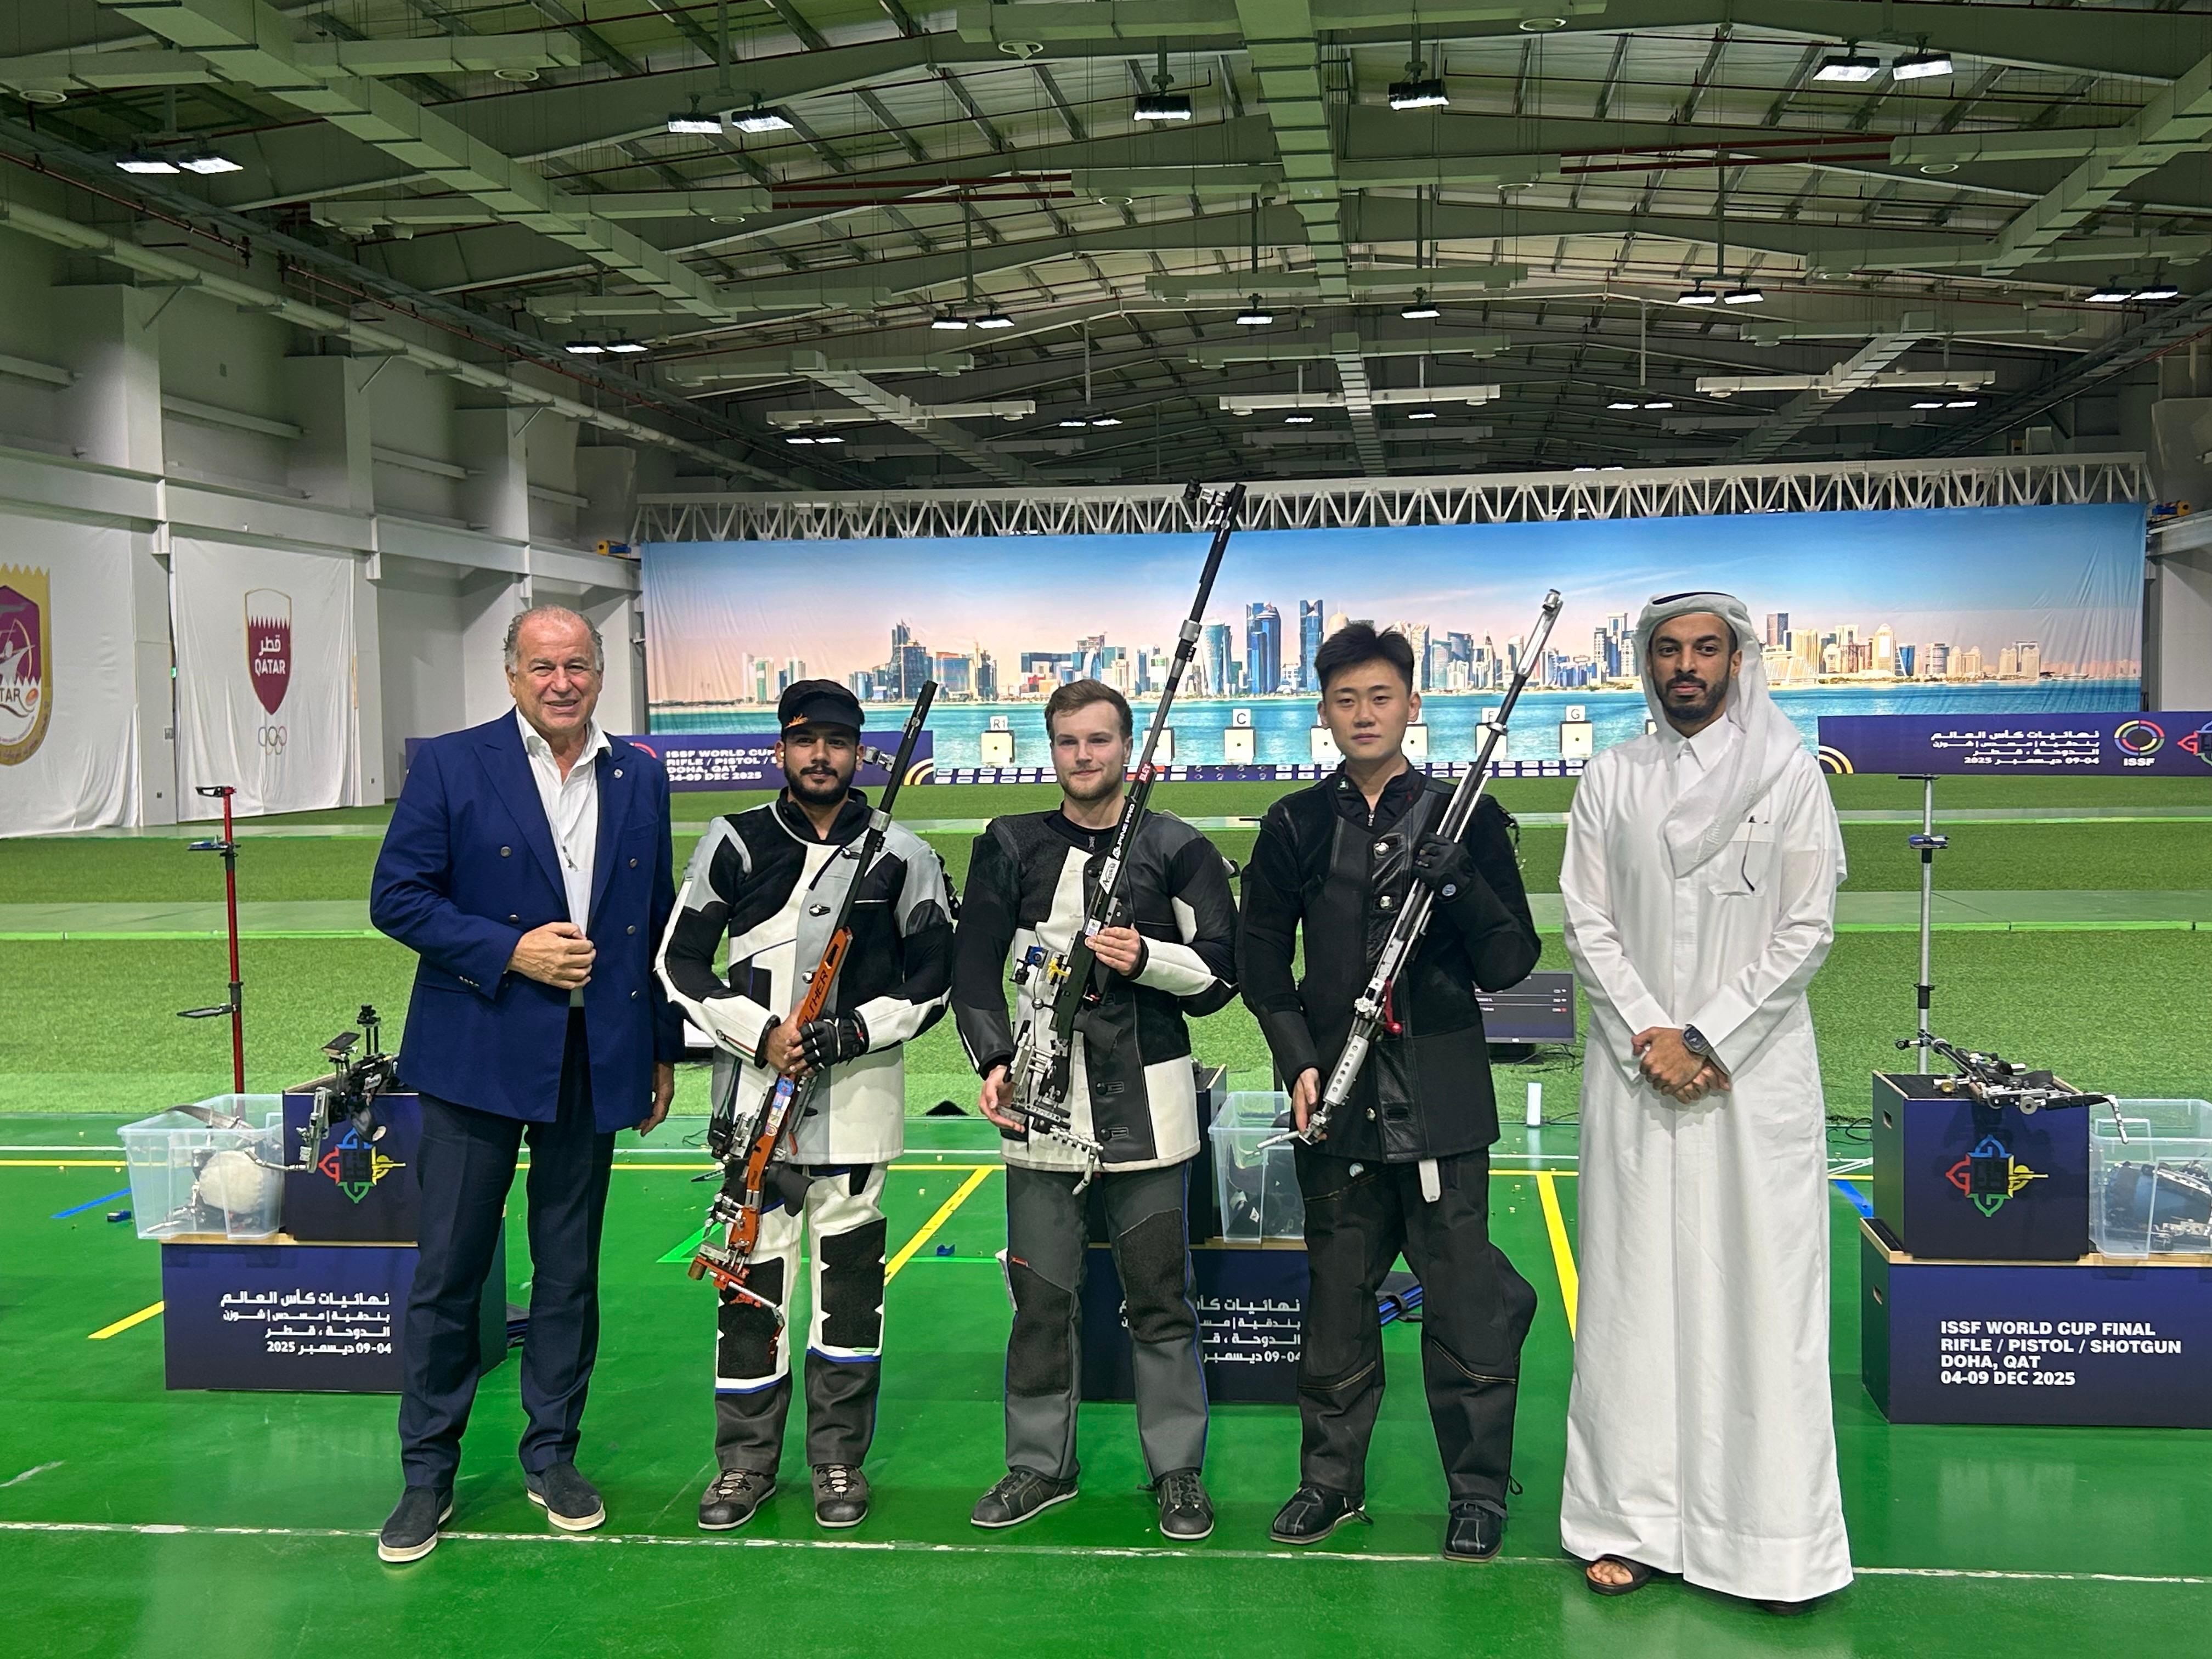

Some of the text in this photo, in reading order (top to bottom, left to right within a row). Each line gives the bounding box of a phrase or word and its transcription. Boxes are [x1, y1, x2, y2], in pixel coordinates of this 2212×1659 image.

[258, 635, 281, 656] قطر
[255, 658, 286, 677] QATAR
[1237, 713, 1246, 724] C
[1571, 709, 1580, 719] G
[994, 719, 1005, 729] R1
[1931, 730, 2100, 741] نهائيات كأس العالم
[2123, 758, 2155, 766] ISSF
[704, 772, 729, 781] DEC
[804, 969, 828, 1024] LTHER
[221, 1289, 390, 1308] نهائيات كأس العالم
[1197, 1295, 1300, 1314] نهائيات كأ
[223, 1309, 266, 1321] شوزن
[272, 1311, 325, 1321] مسدس
[331, 1310, 390, 1323] بندقية
[1238, 1318, 1301, 1330] بندقية
[1941, 1321, 2155, 1336] ISSF WORLD CUP FINAL
[265, 1325, 316, 1338] قطر
[325, 1325, 390, 1339] الدوحة
[1232, 1333, 1301, 1347] الدوحة
[1941, 1338, 2181, 1354] RIFLE / PISTOL / SHOTGUN
[267, 1341, 296, 1353] 2025
[297, 1344, 355, 1356] ديسمبر
[1204, 1352, 1262, 1364] ديسمبر
[1941, 1355, 2041, 1370] DOHA, QAT
[1941, 1371, 2076, 1385] 04-09 DEC 2025
